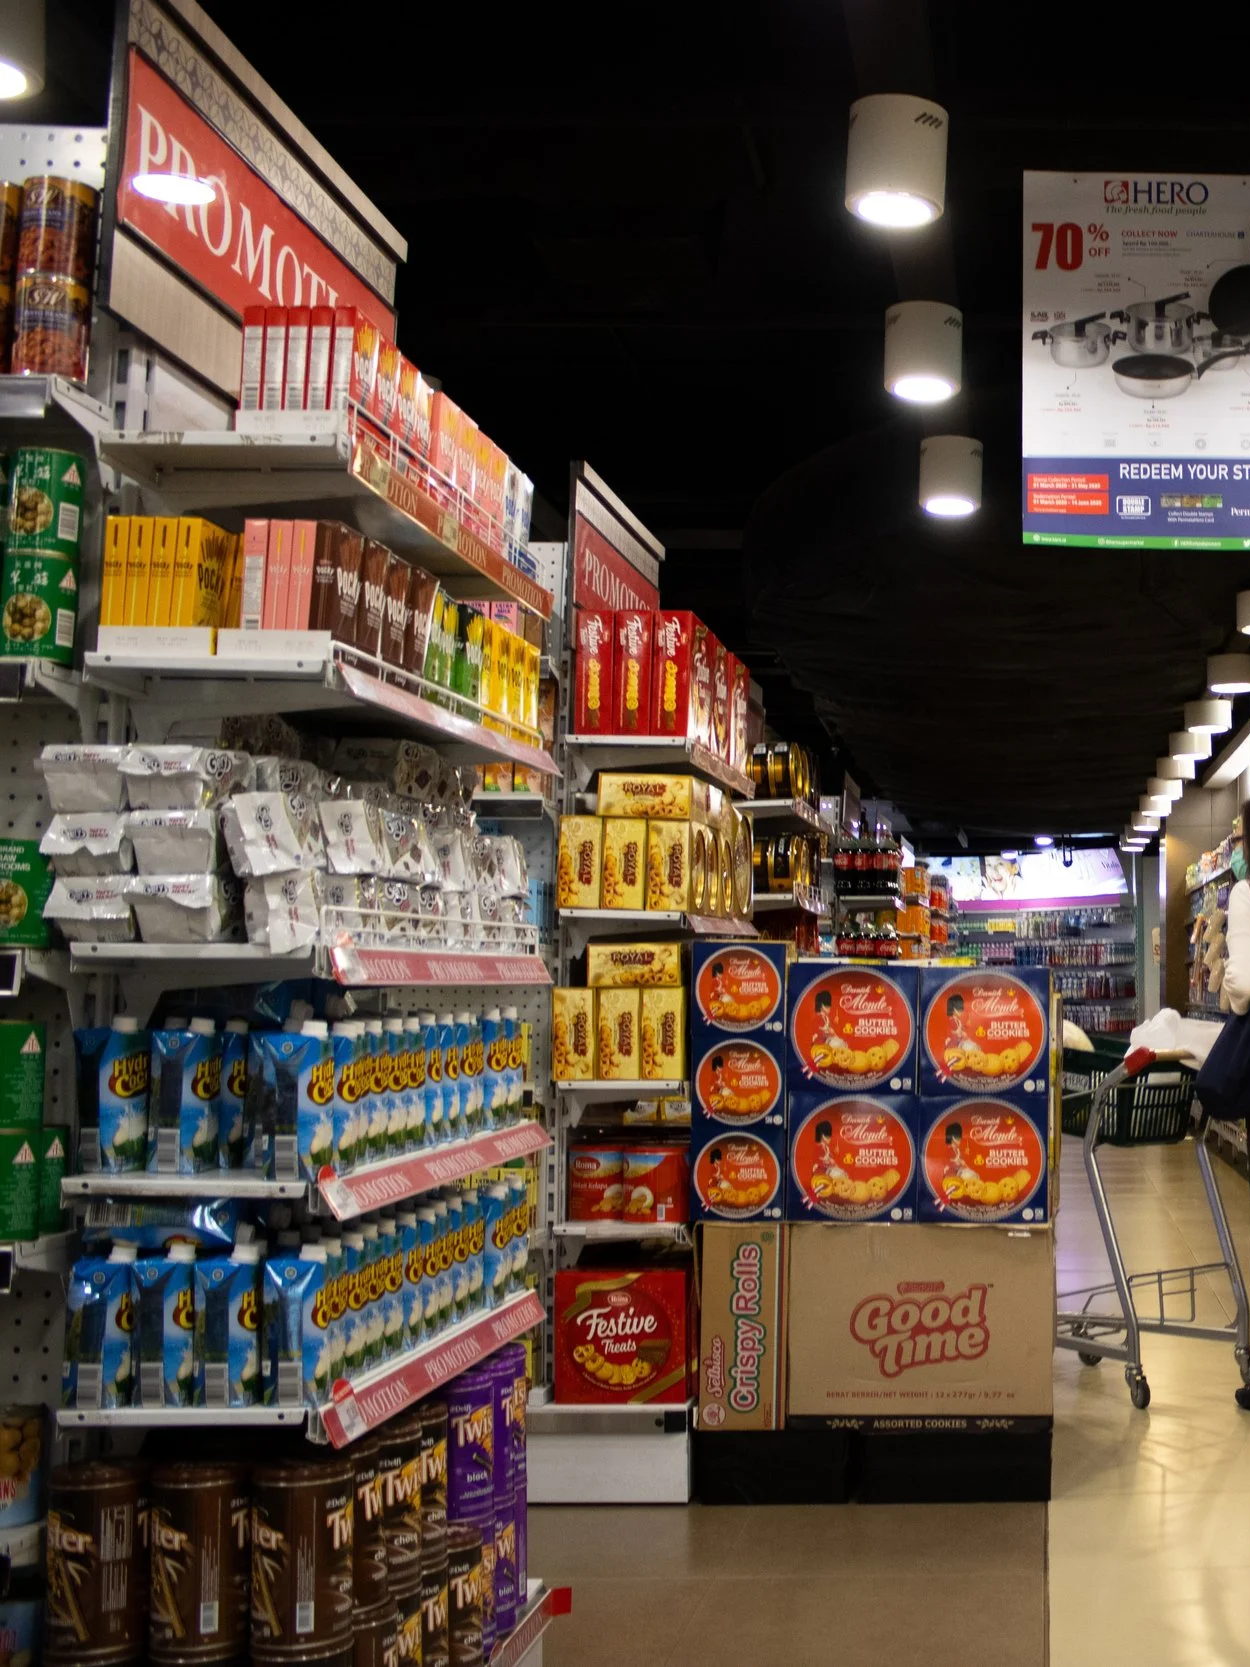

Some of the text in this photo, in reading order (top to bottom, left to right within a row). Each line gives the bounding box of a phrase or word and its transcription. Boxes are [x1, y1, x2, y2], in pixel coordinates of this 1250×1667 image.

[1133, 181, 1209, 205] HERO
[136, 103, 340, 308] PROMOT
[1105, 205, 1208, 217] The fresh food people
[1121, 230, 1156, 238] COLLECT
[1088, 247, 1111, 258] OFF
[1119, 463, 1183, 480] REDEEM
[1188, 464, 1229, 480] YOUR
[584, 548, 650, 610] PROMOT
[623, 783, 665, 795] ROYAL
[579, 840, 592, 885] ROYAL
[623, 841, 637, 886] ROYAL
[667, 844, 682, 888] ROYAL
[611, 951, 651, 963] ROYAL
[840, 992, 888, 1014] Monde
[971, 996, 1019, 1017] Monde
[854, 1026, 897, 1035] COOKIES
[858, 1018, 894, 1027] BUTTER
[986, 1029, 1030, 1038] COOKIES
[990, 1021, 1027, 1029] BUTTER
[577, 1013, 588, 1056] ROYAL
[623, 1013, 633, 1056] ROYAL
[664, 1013, 676, 1056] ROYAL
[113, 1053, 149, 1075] Hydr
[840, 1123, 888, 1145] Monde
[970, 1124, 1018, 1146] Monde
[854, 1156, 898, 1166] COOKIES
[858, 1148, 895, 1157] BUTTER
[985, 1157, 1029, 1166] COOKIES
[989, 1149, 1025, 1157] BUTTER
[424, 1149, 485, 1181] PROMOTION
[574, 1160, 597, 1170] Roma
[491, 1300, 538, 1340] PROMOTION
[577, 1306, 658, 1341] Festive
[852, 1284, 986, 1342] Good
[730, 1243, 766, 1411] Crispy Rolls
[601, 1339, 637, 1355] Treats
[873, 1325, 990, 1378] Time
[424, 1334, 482, 1383] PROMOTION
[450, 1413, 493, 1448] Twis
[873, 1419, 967, 1429] ASSORTED COOKIES
